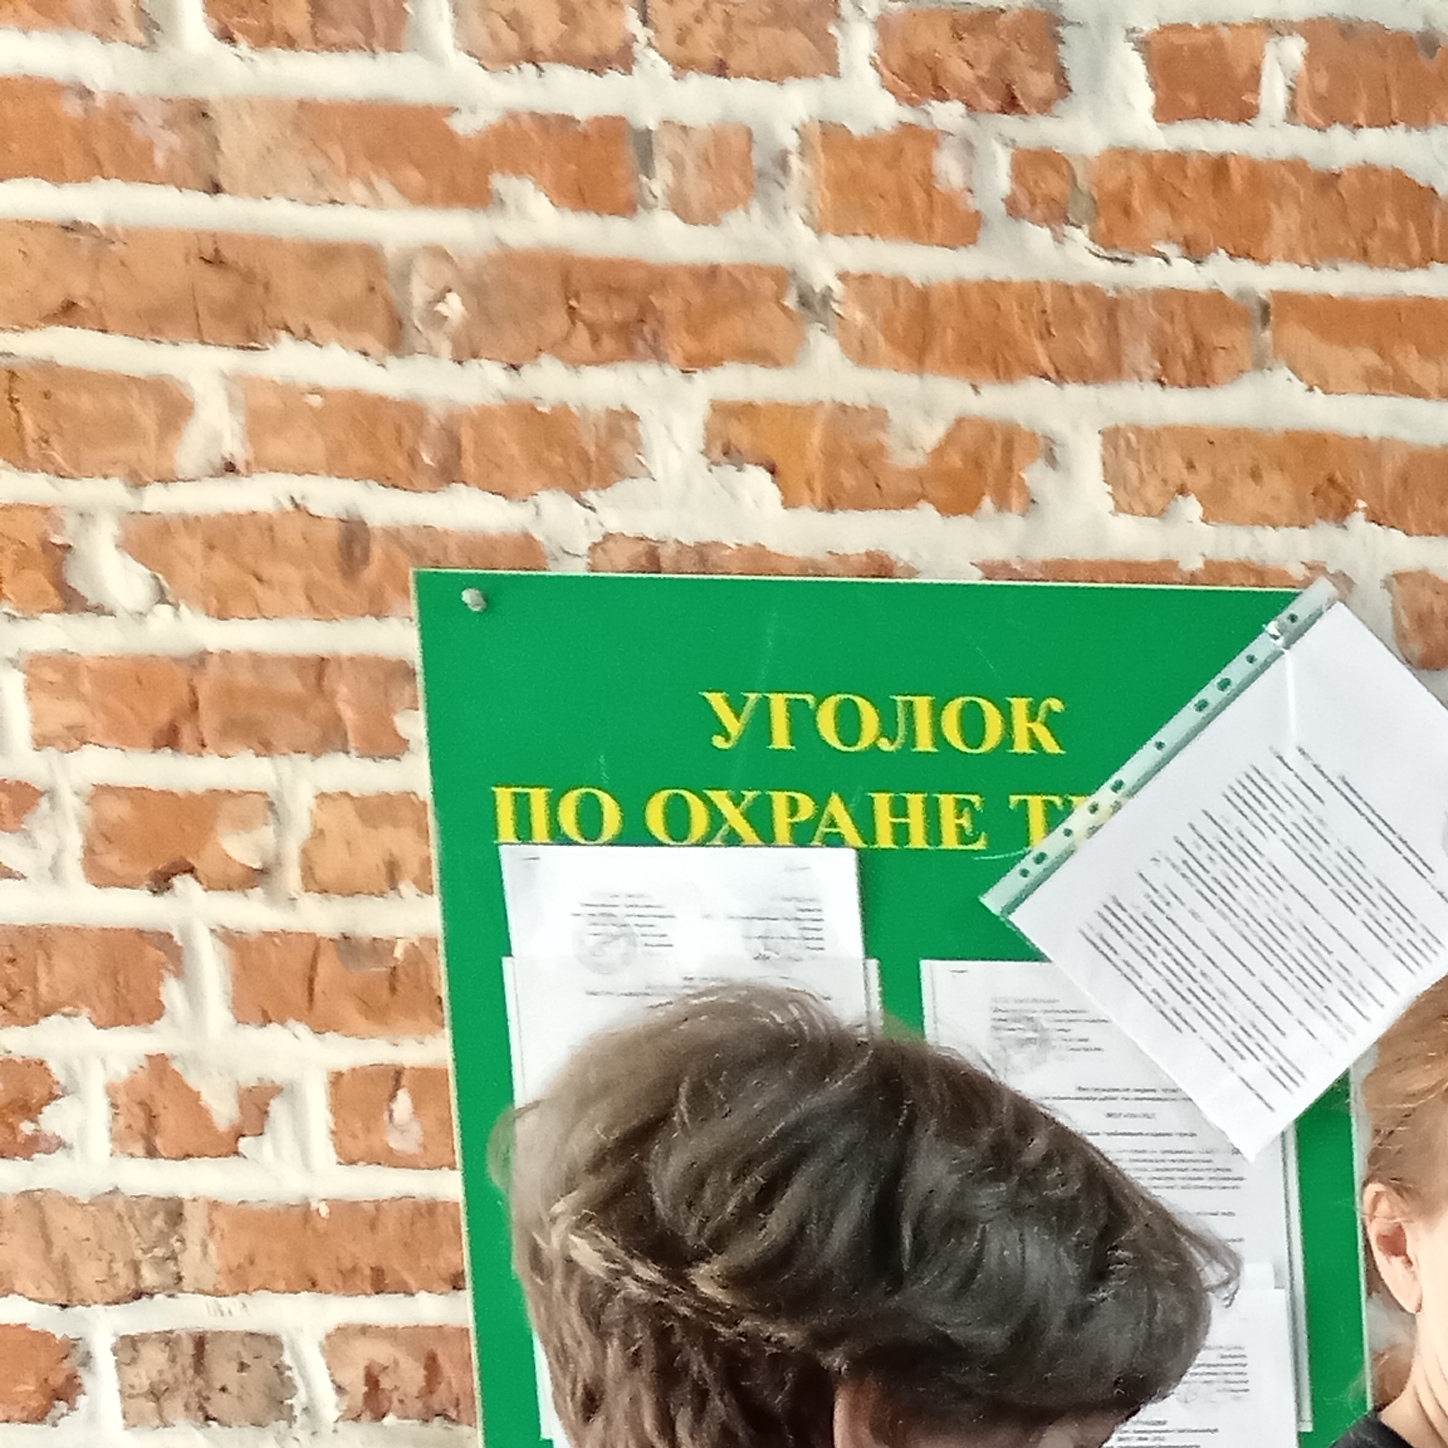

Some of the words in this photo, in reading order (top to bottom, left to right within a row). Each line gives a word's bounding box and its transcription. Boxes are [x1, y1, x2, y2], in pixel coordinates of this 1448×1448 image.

[700, 690, 1065, 756] УГОЛОК
[492, 786, 623, 846] ПО
[644, 788, 990, 850] ОХРАНЕ
